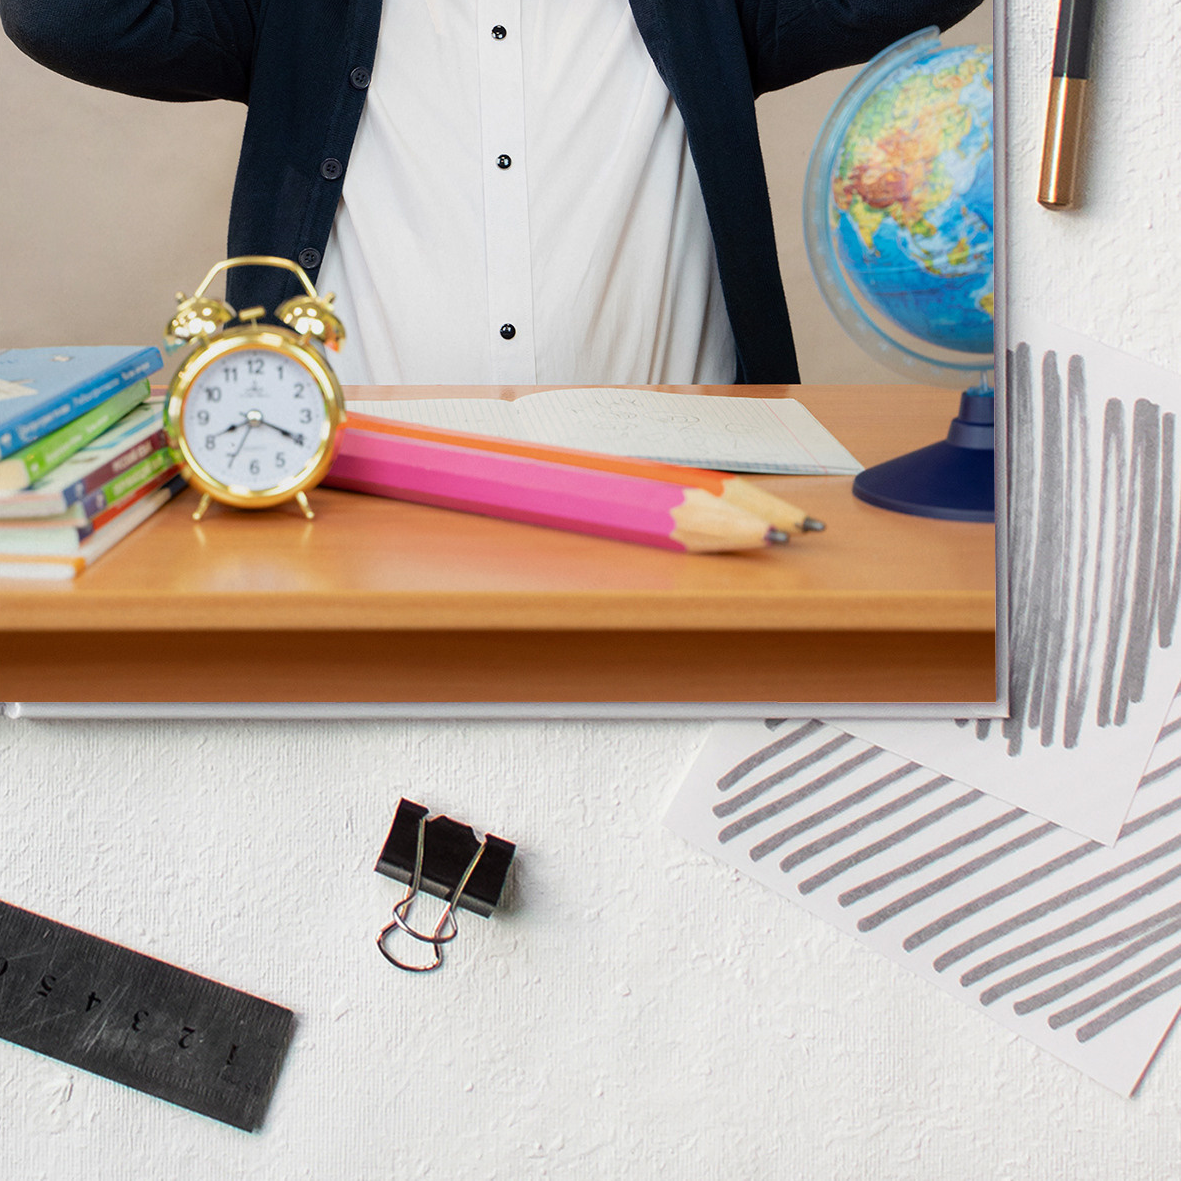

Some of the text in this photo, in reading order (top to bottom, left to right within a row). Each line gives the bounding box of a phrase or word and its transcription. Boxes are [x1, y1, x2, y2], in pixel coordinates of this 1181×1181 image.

[223, 367, 238, 382] 11
[247, 358, 265, 375] 12
[277, 365, 283, 380] 1
[205, 387, 222, 402] 10
[294, 383, 305, 399] 2
[197, 410, 209, 425] 9
[299, 409, 312, 424] 3
[205, 435, 216, 450] 8
[249, 459, 260, 475] 6
[275, 452, 285, 467] 5
[37, 974, 57, 998] 5
[85, 991, 102, 1013] 4
[131, 1010, 149, 1032] 3
[178, 1026, 195, 1049] 2
[227, 1043, 238, 1065] 1
